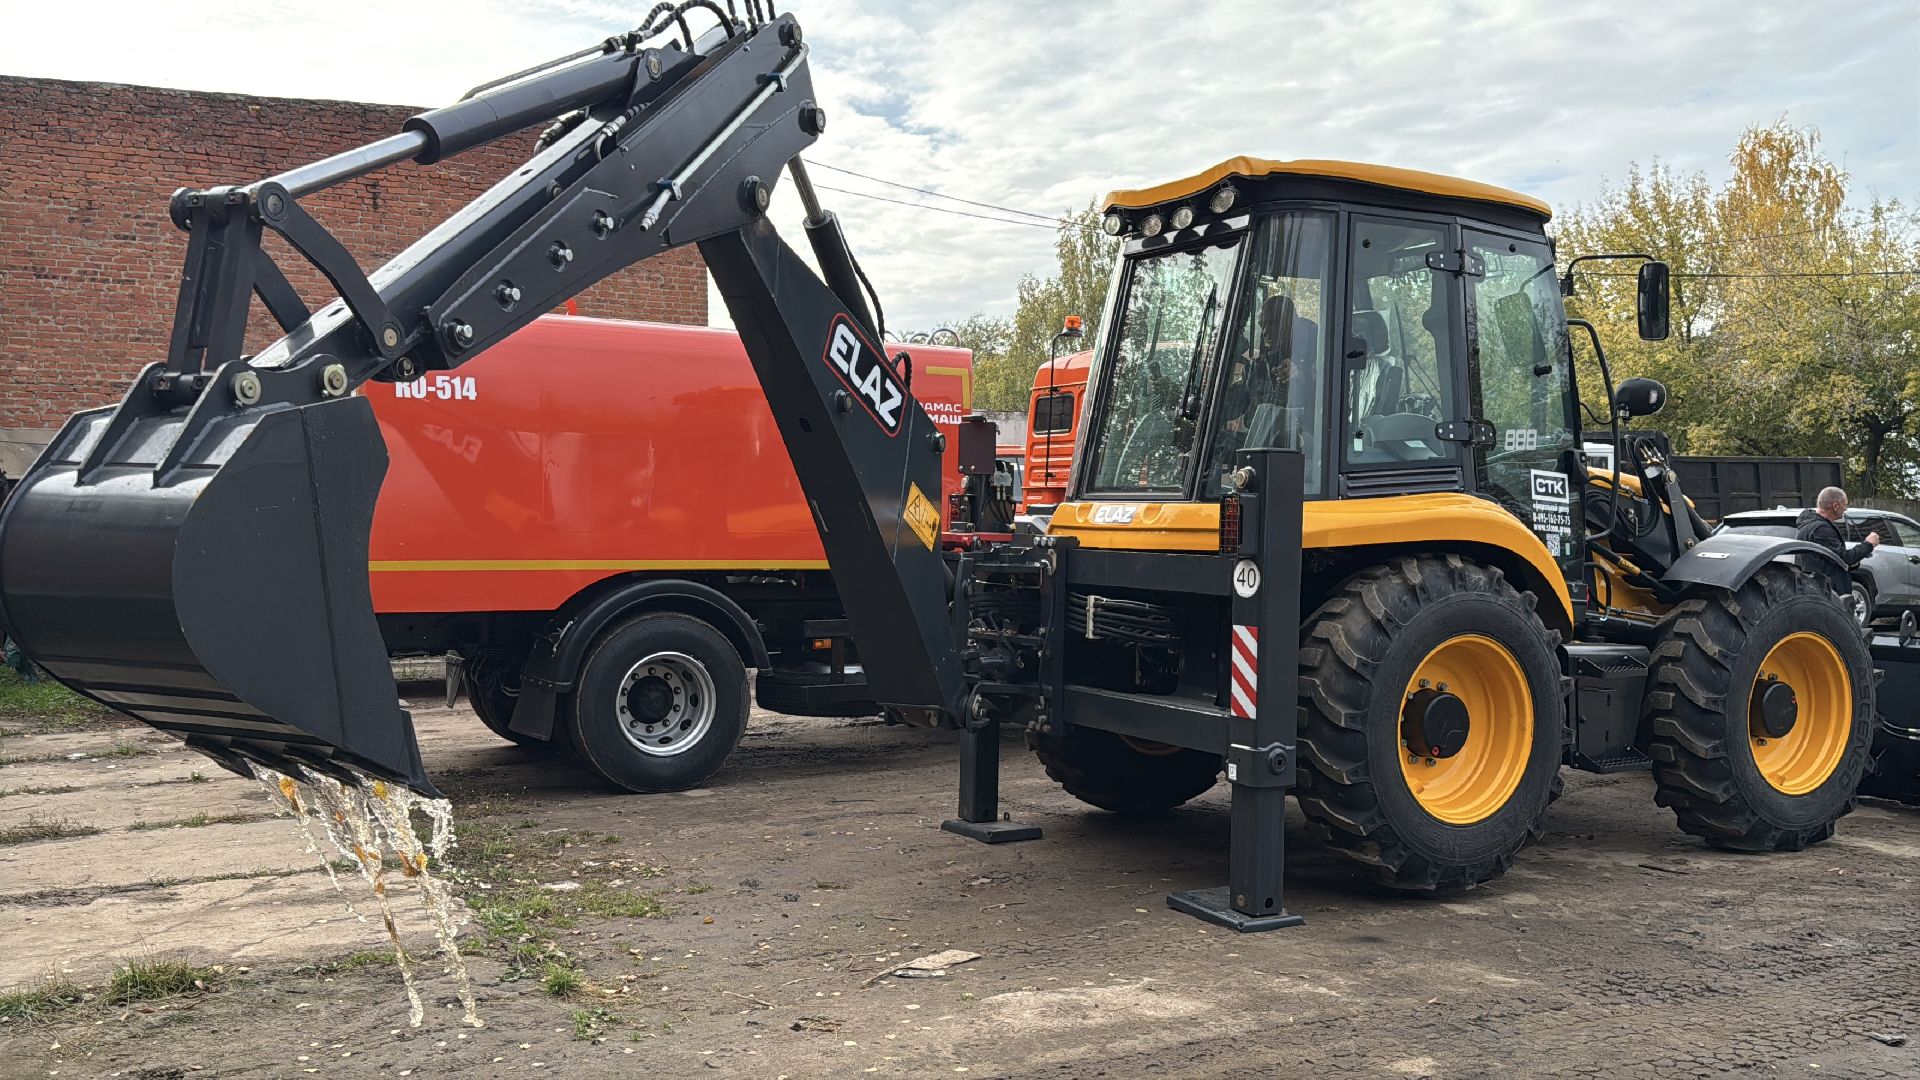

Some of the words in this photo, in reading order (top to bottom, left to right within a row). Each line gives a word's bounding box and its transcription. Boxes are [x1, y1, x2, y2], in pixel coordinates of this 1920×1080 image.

[829, 323, 902, 427] ELAZ
[1094, 505, 1137, 523] ELAZ
[1236, 567, 1257, 589] 40
